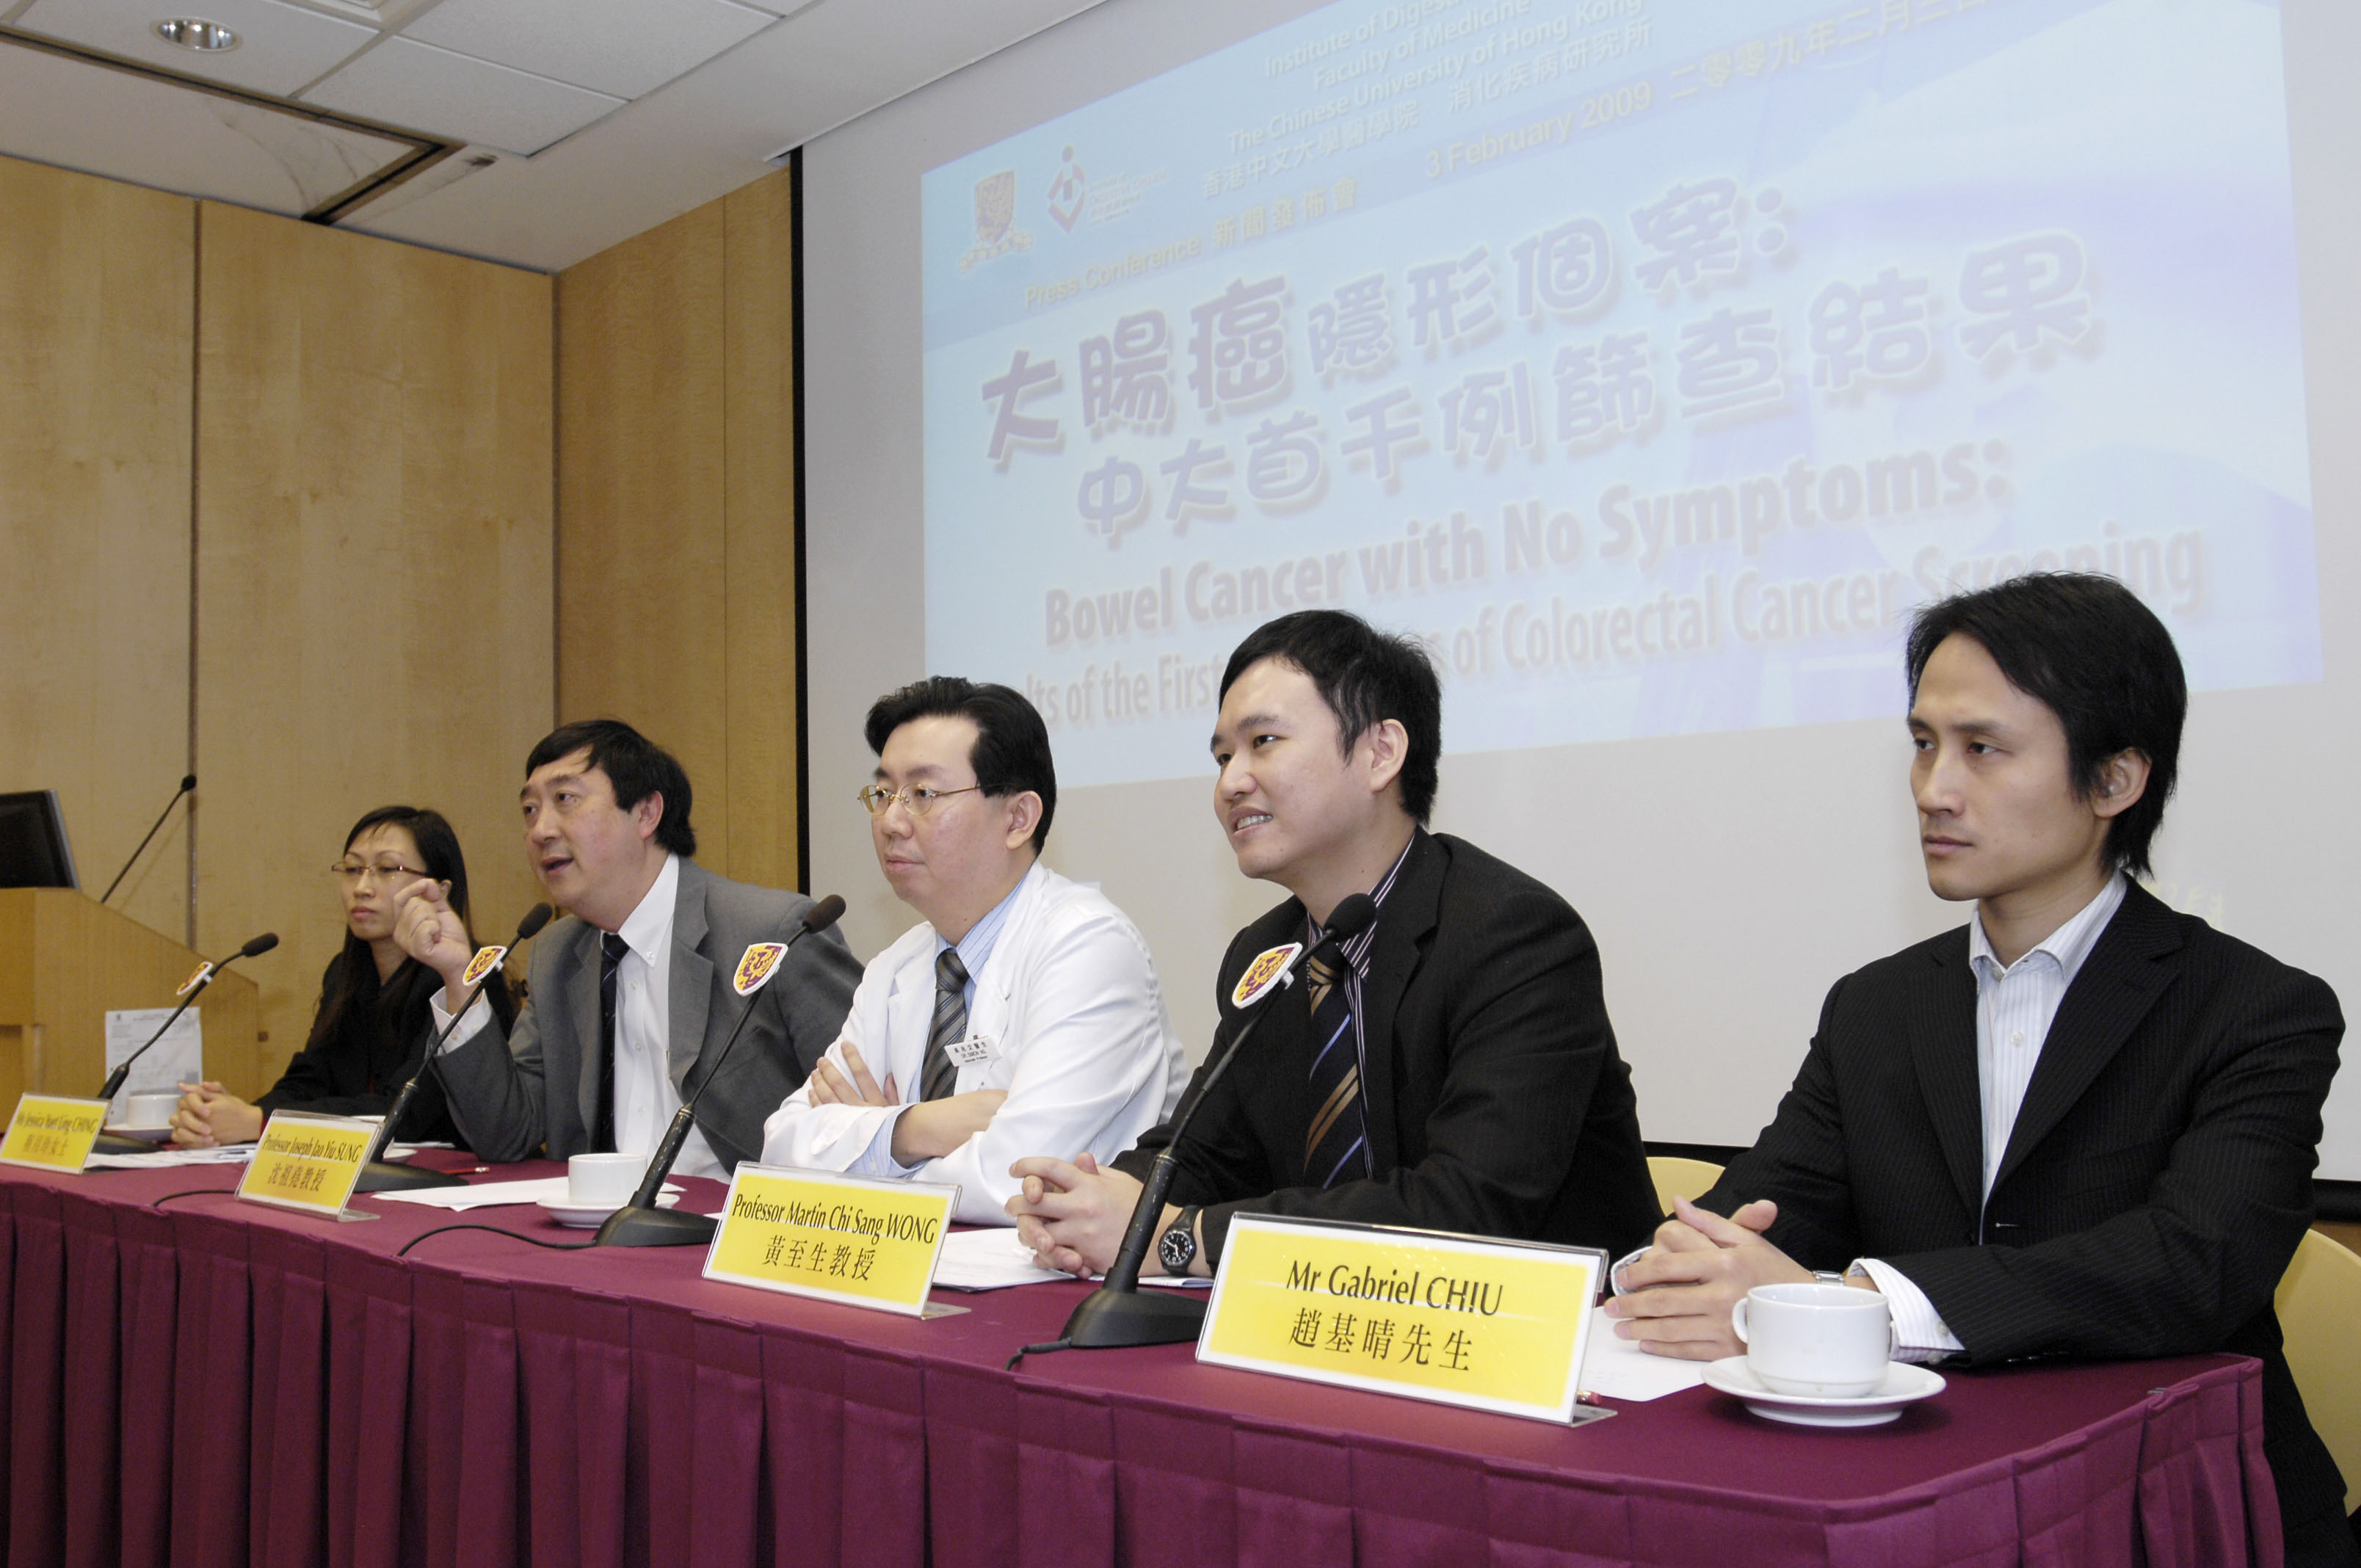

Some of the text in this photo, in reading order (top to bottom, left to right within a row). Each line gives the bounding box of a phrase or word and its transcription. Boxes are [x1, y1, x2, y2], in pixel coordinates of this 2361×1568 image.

[1227, 0, 1645, 153] The Chinese University of Hong Kong
[1266, 29, 1352, 77] Institute
[1355, 11, 1379, 43] of
[1313, 0, 1531, 90] Faculty of Medicine
[1202, 15, 1653, 199] 香港中文大學醫學院 消化疾病研究所
[1024, 0, 1986, 309] Press Conference 新聞發佈會 3 February 2009 二零零九年二月三
[1077, 230, 2091, 536] 中大首千例篩查結果
[1045, 438, 2006, 647] Bowel Cancer with No Symptoms:
[1066, 663, 1095, 722] of
[1100, 659, 1149, 719] the
[1158, 652, 1225, 711] First
[1454, 605, 1493, 675] of
[1503, 572, 1719, 669] Colorectal
[1732, 566, 1901, 644] Cancer
[287, 1136, 313, 1160] Joseph
[334, 1142, 363, 1164] SUNG
[732, 1193, 937, 1245] Professor Martin Chi Sang WONG
[761, 1235, 876, 1281] 黃至生教授
[1286, 1260, 1504, 1316] Mr Gabriel CHIU
[1288, 1307, 1473, 1371] 趙基晴先生
